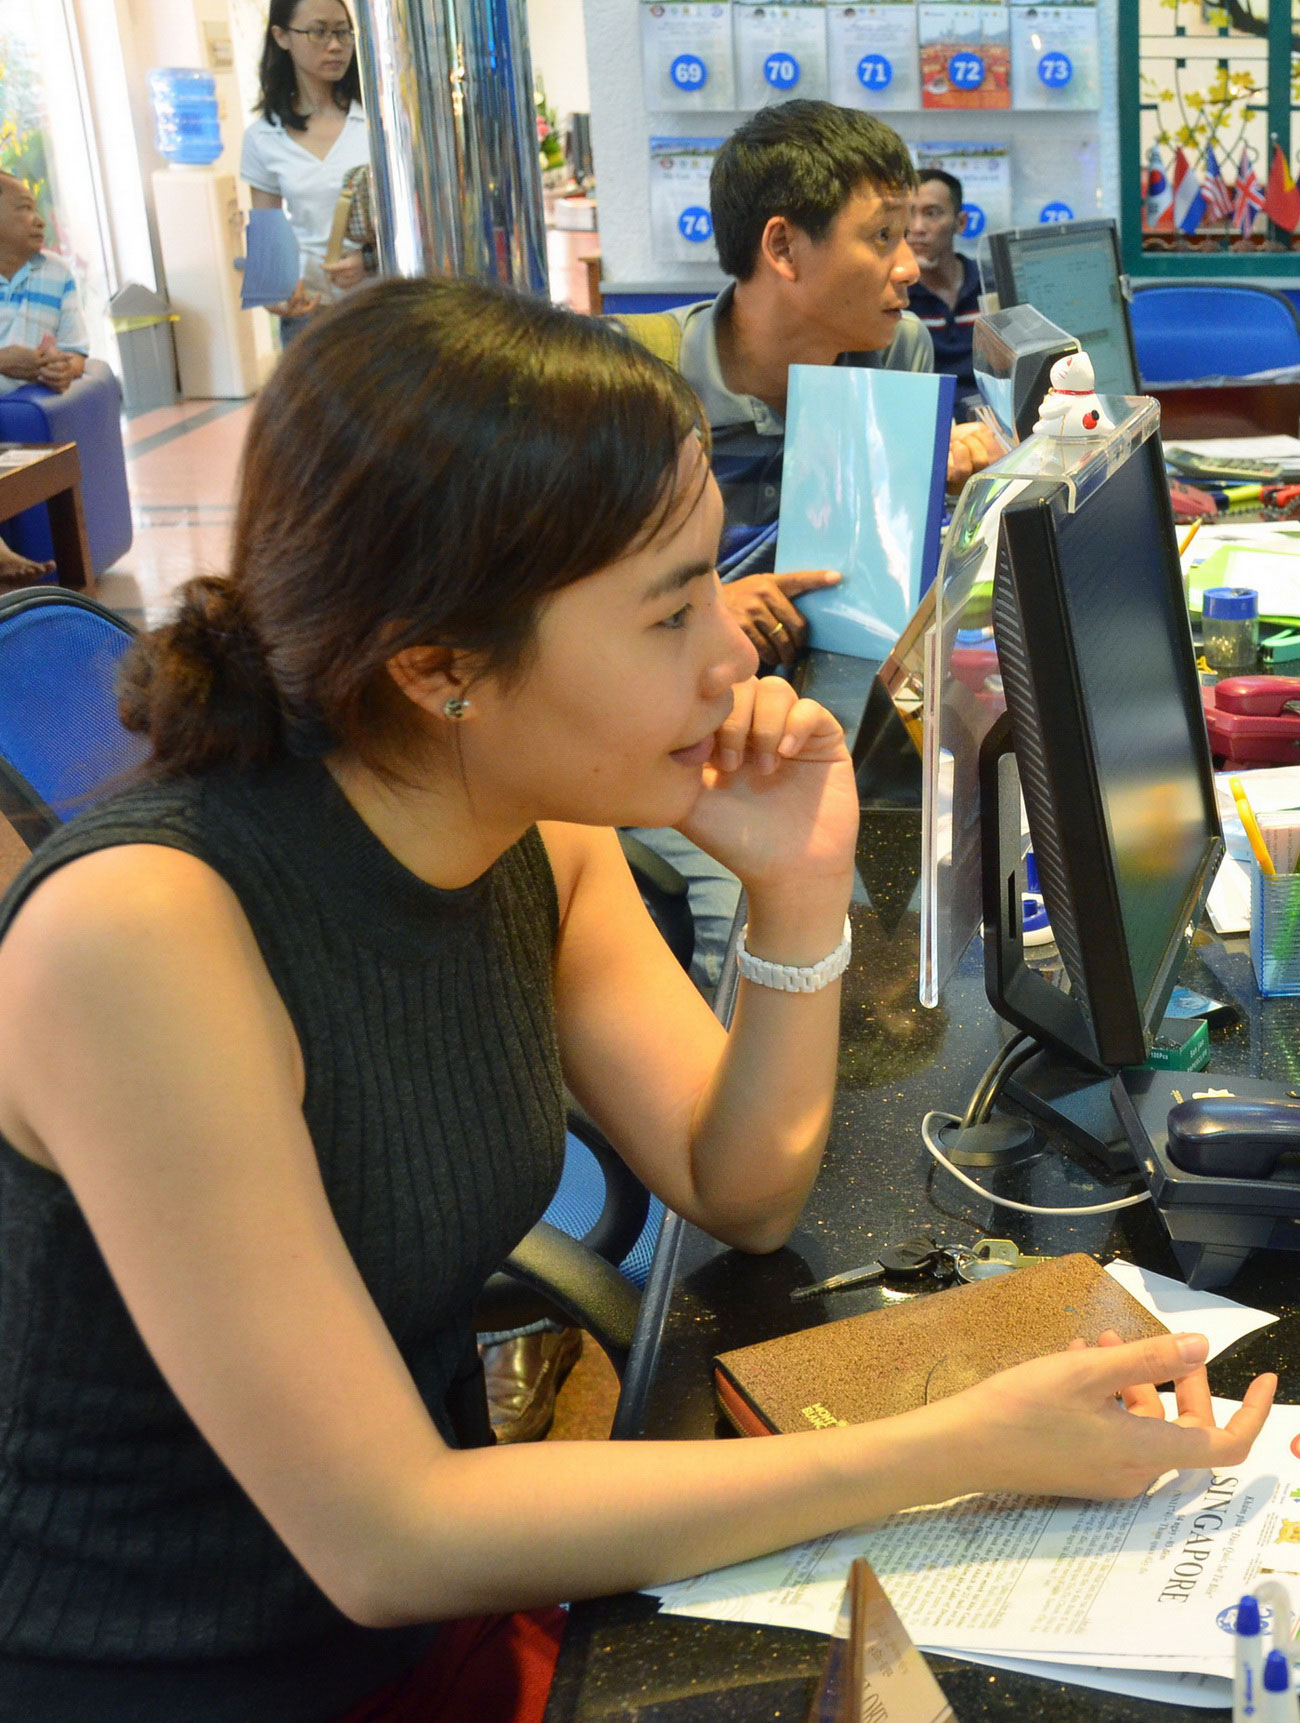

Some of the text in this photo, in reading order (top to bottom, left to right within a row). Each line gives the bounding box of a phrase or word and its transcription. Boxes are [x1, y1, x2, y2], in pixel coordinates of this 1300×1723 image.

[675, 62, 702, 82] 69
[767, 61, 794, 81] 70
[861, 62, 886, 82] 71
[954, 62, 979, 81] 72
[1042, 61, 1067, 80] 73
[683, 215, 709, 235] 74
[1158, 1474, 1238, 1604] SINGAPORE
